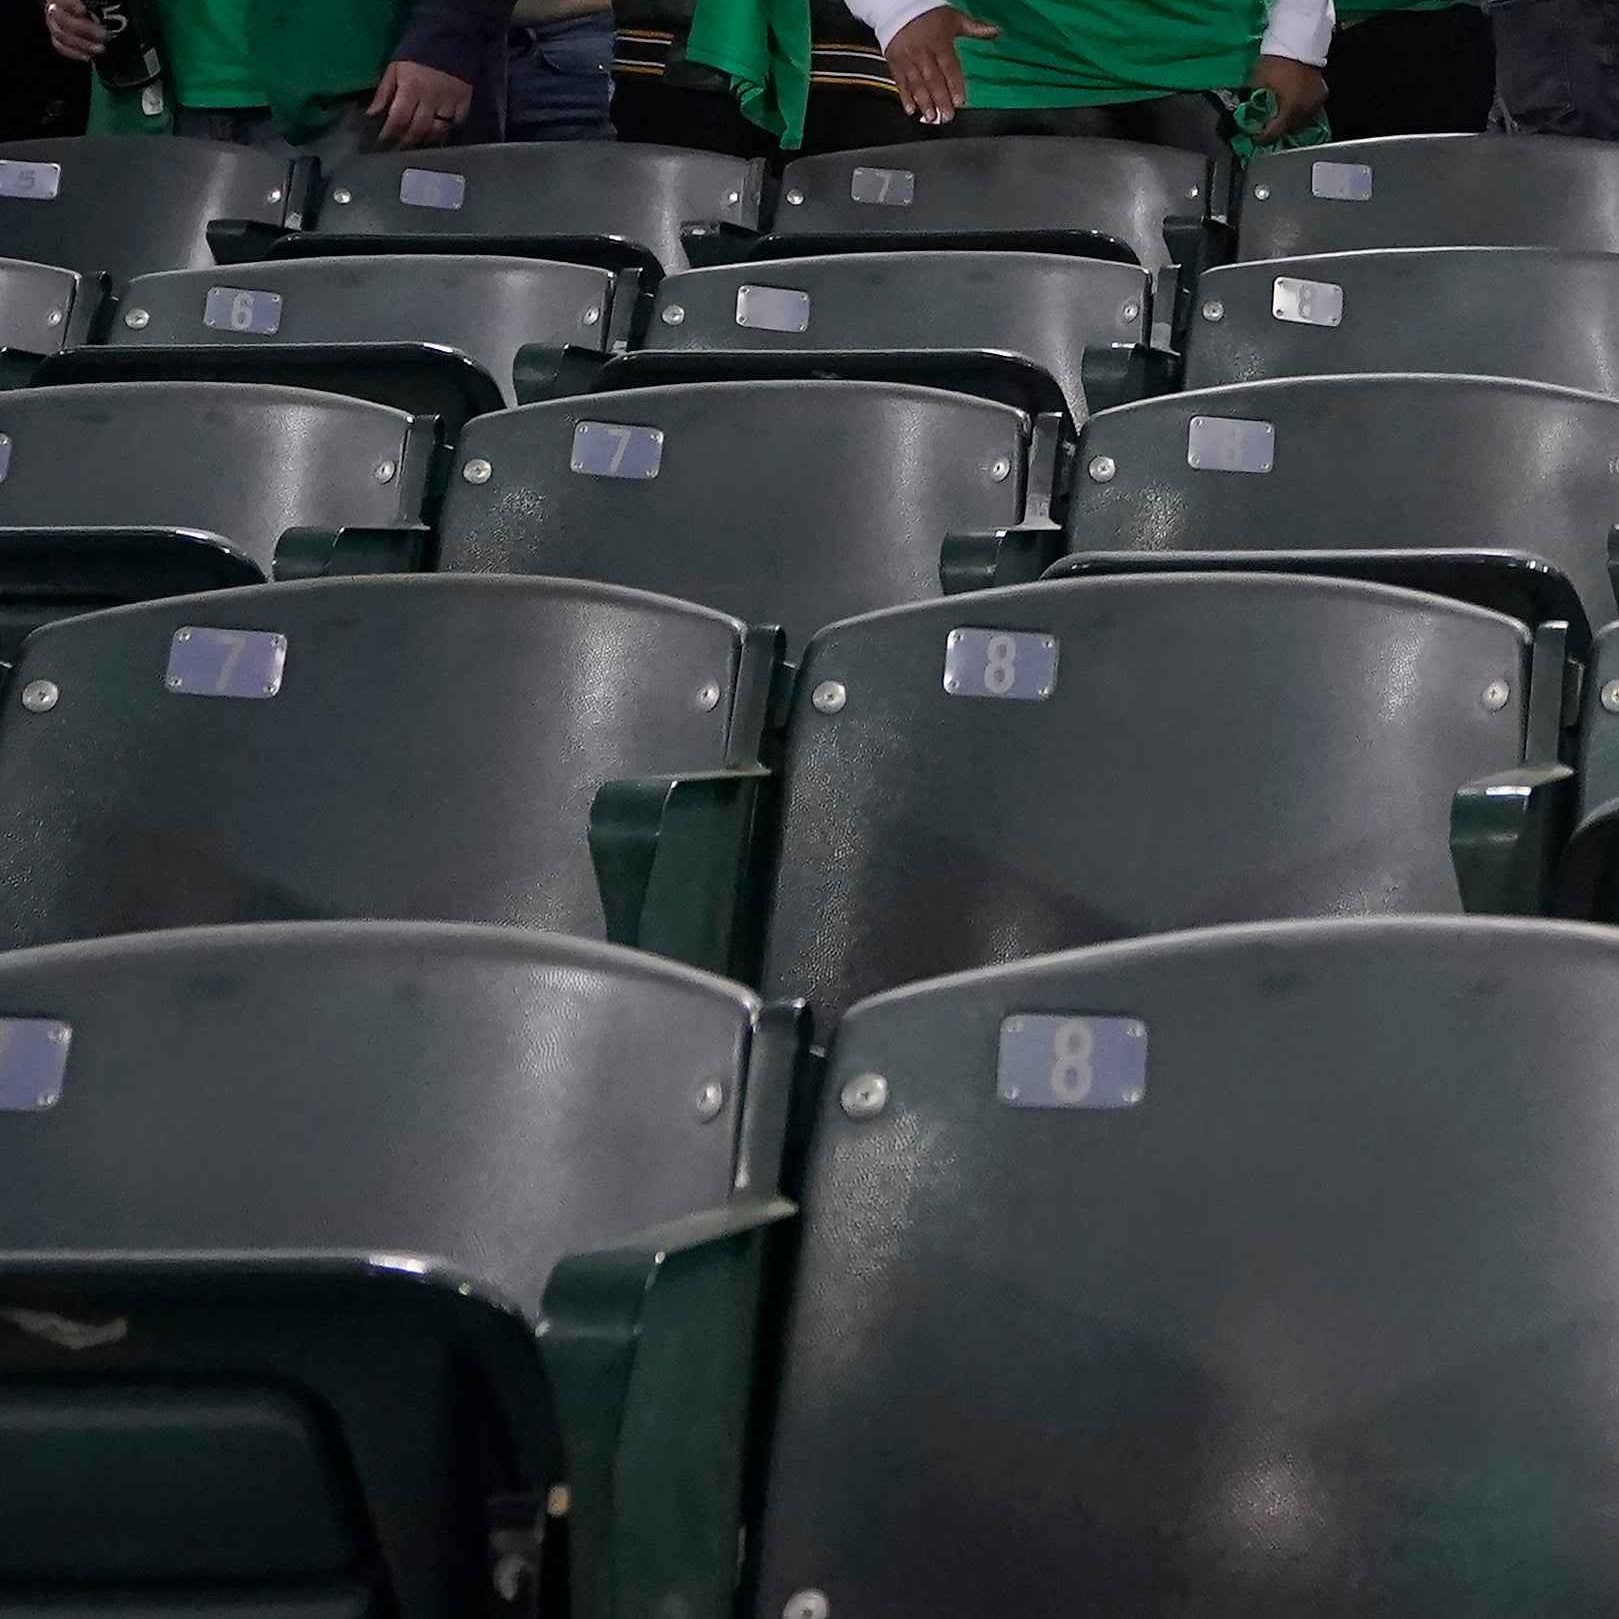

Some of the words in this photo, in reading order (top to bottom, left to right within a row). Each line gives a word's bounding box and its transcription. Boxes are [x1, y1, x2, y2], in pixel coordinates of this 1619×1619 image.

[231, 290, 255, 330] 6
[608, 427, 633, 472] 7
[216, 634, 246, 691] 7
[986, 634, 1016, 695] 8
[1052, 1020, 1093, 1103] 8
